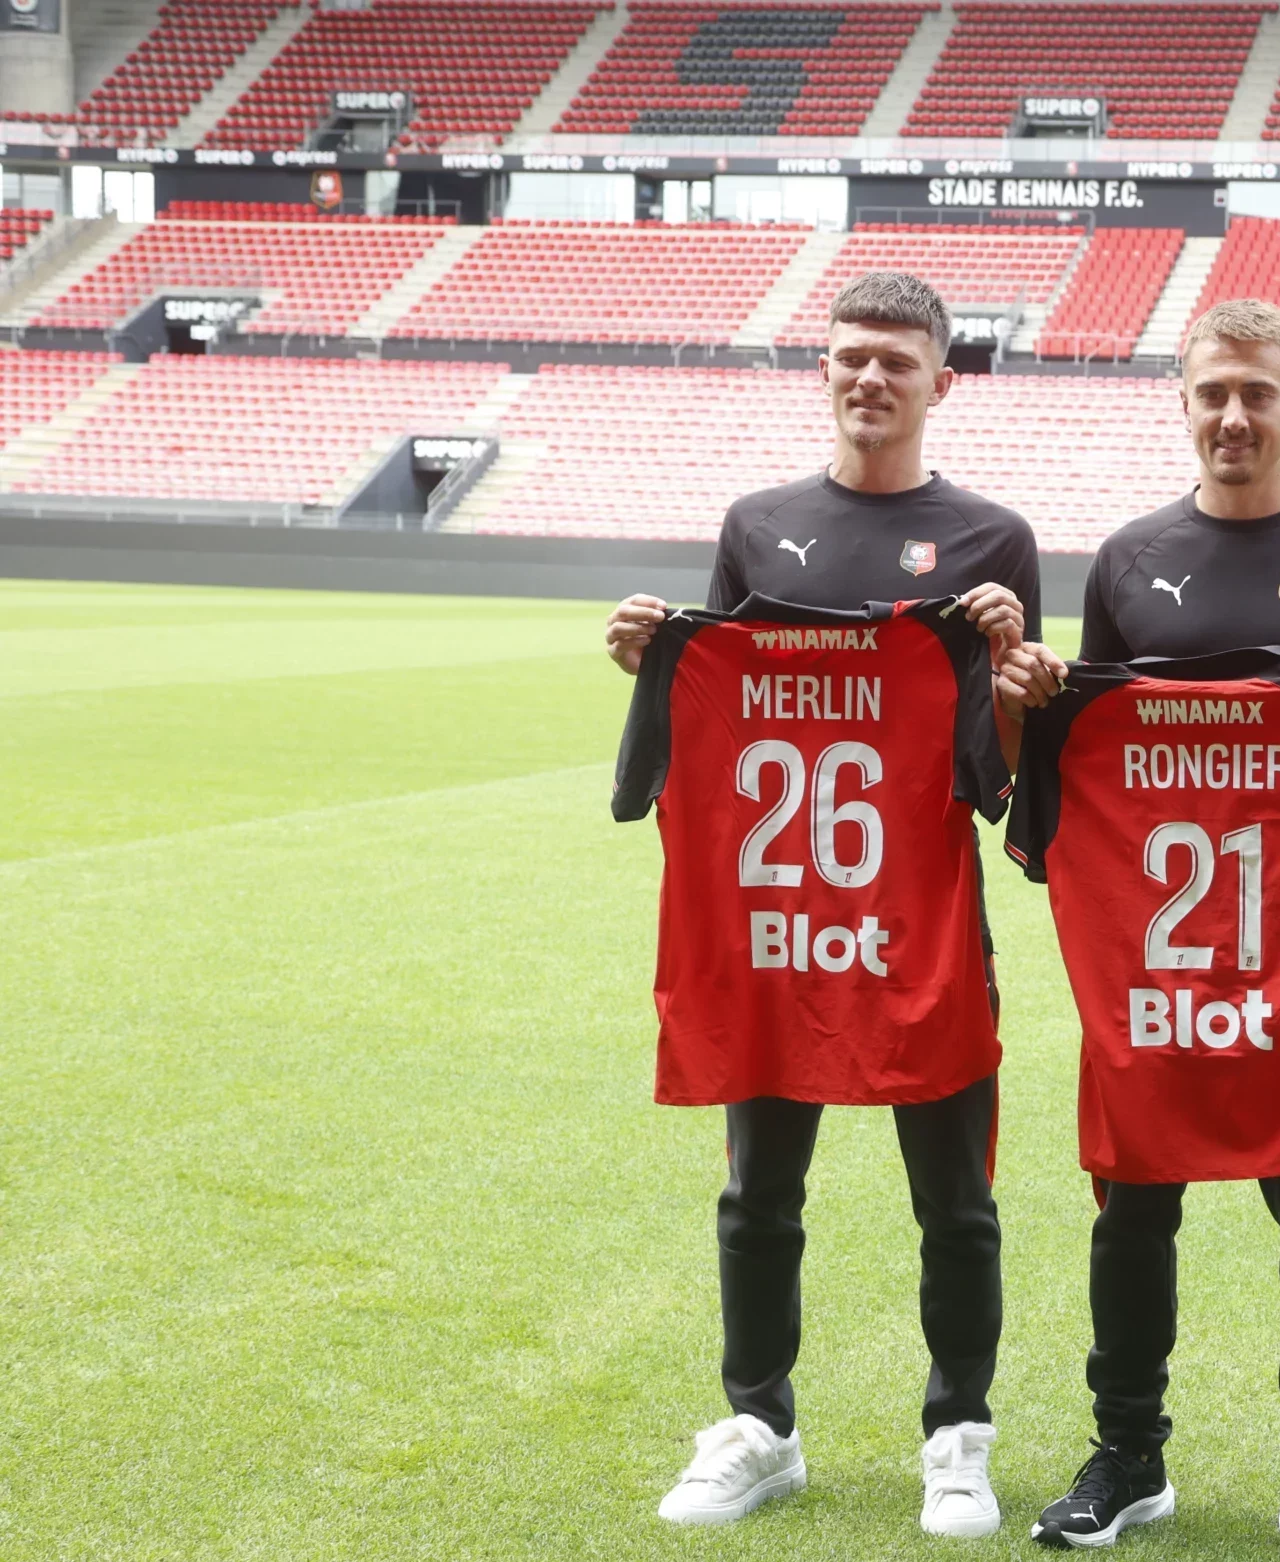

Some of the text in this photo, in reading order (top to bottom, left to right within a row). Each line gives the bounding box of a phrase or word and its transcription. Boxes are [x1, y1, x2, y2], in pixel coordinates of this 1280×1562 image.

[1025, 98, 1082, 116] SUPER
[442, 154, 489, 169] HYPER
[523, 155, 568, 170] SUPER
[778, 158, 825, 173] HYPER
[860, 159, 909, 174] SUPER
[959, 160, 1013, 175] express
[1127, 162, 1178, 177] HYPER
[1213, 163, 1262, 178] SUPER
[928, 178, 1144, 208] STADE RENNAIS F.C.
[751, 627, 878, 651] WINAMAX
[742, 674, 881, 721] MERLIN
[1136, 699, 1264, 725] WINAMAX
[735, 739, 884, 889] 26
[1143, 821, 1263, 972] 21
[750, 911, 889, 978] Blot
[1128, 988, 1273, 1051] Blot
